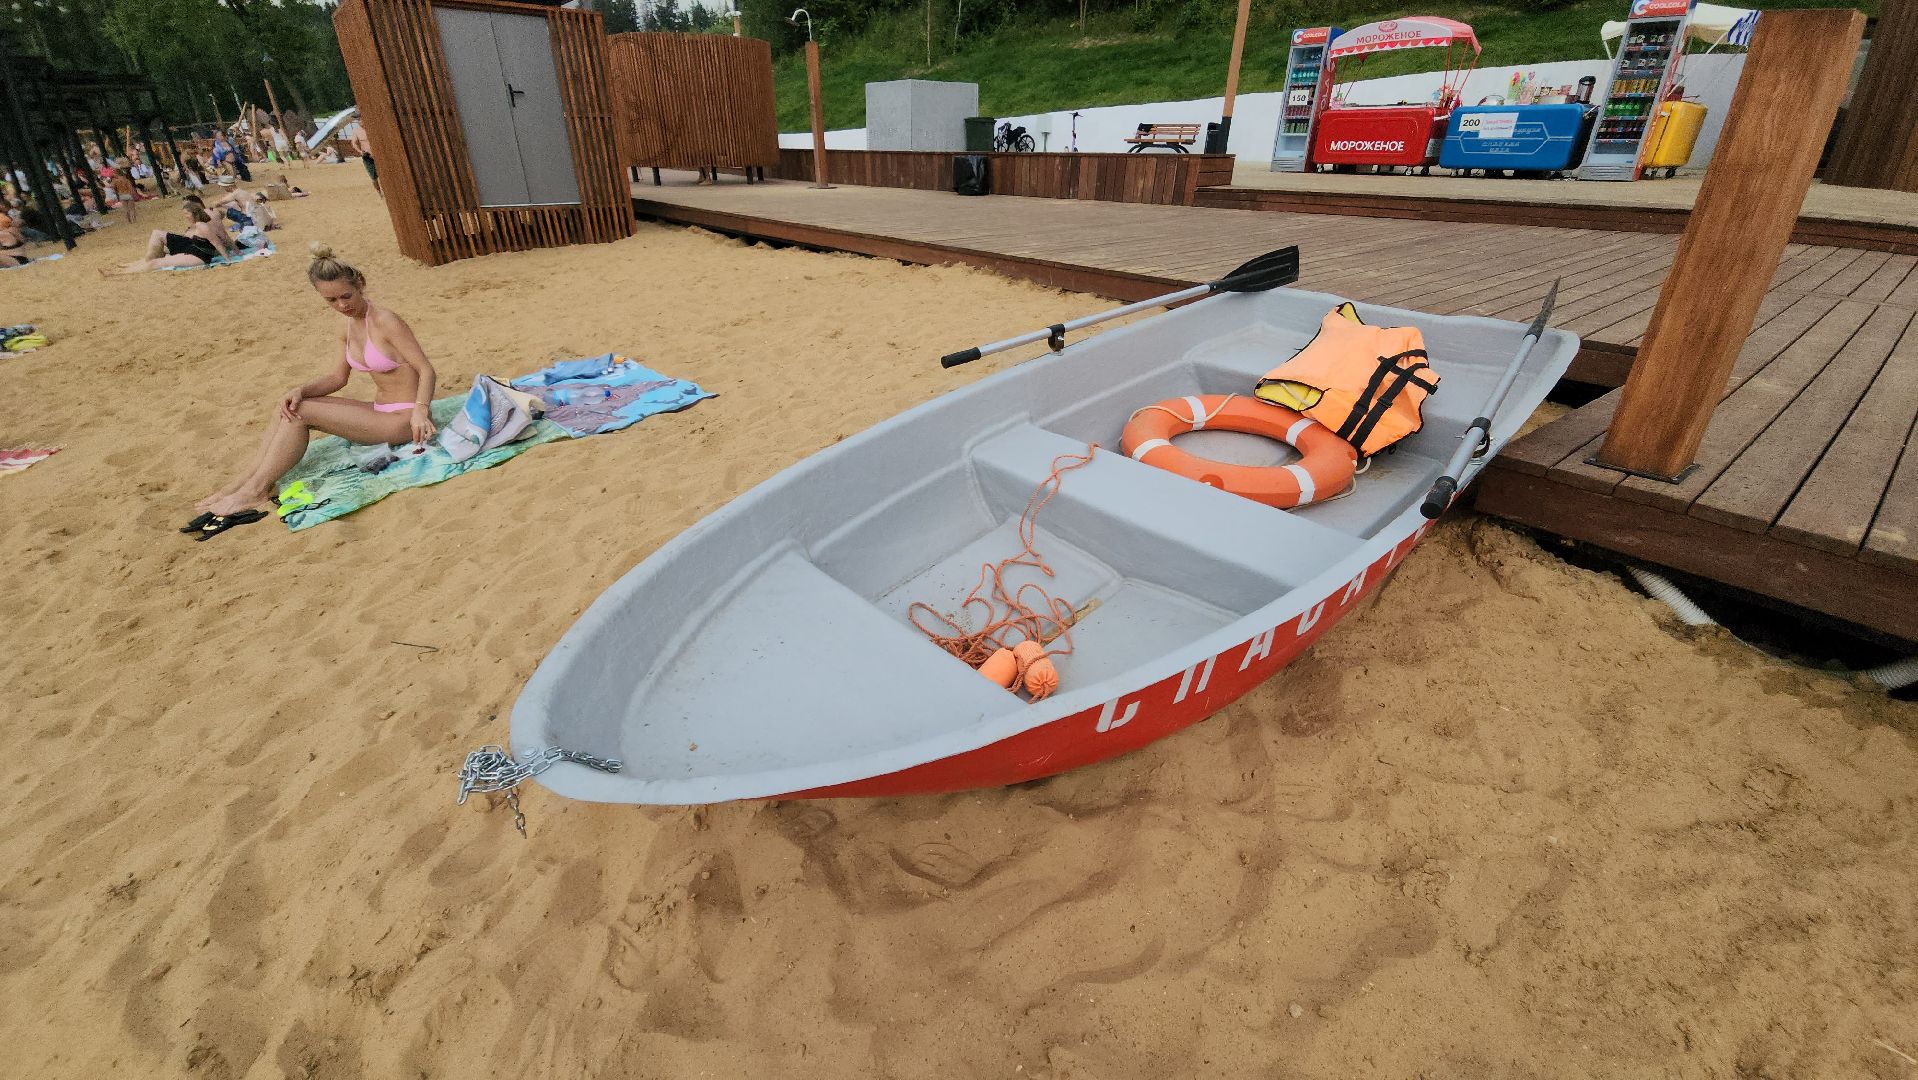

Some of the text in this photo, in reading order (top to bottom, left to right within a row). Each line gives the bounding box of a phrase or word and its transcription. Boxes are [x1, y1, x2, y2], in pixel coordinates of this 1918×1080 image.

[1356, 30, 1422, 45] МОРОЖЕНОЕ
[1292, 94, 1306, 102] 150
[1462, 118, 1481, 127] 200
[1329, 140, 1405, 152] МОРОЖЕНОЕ
